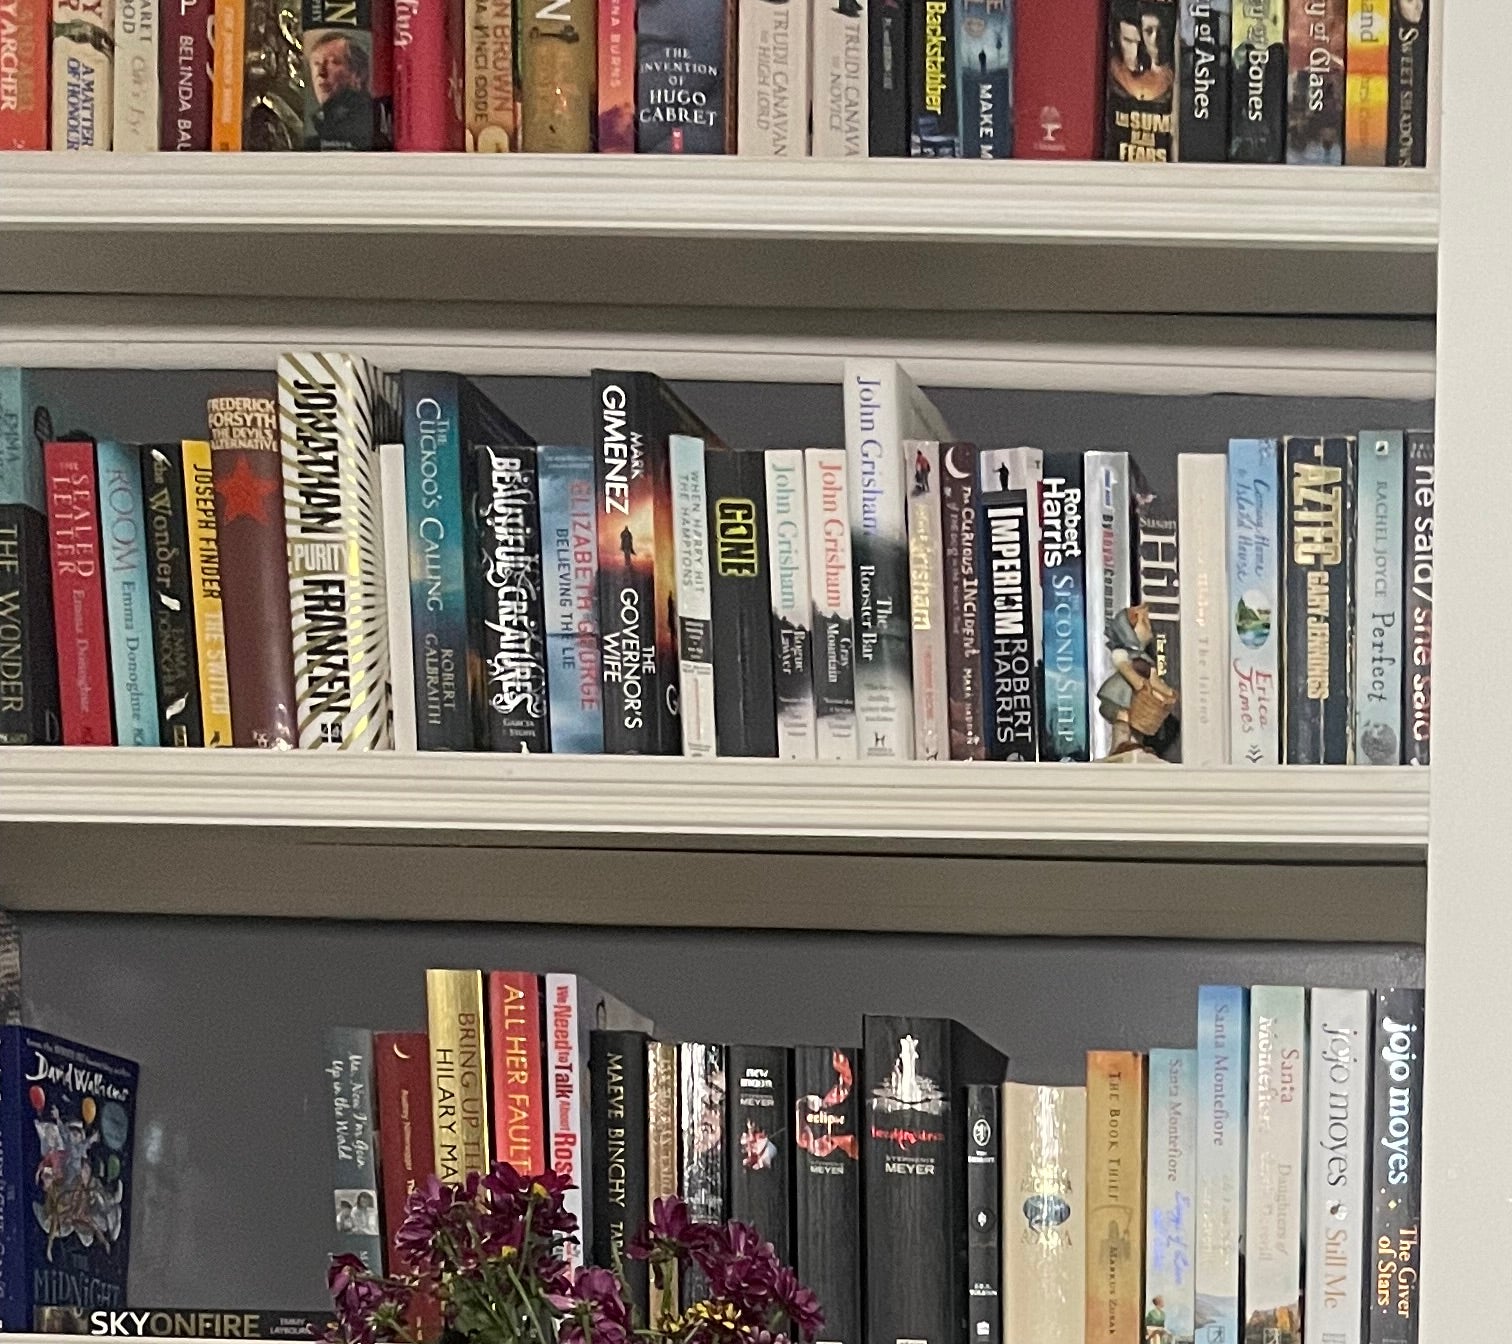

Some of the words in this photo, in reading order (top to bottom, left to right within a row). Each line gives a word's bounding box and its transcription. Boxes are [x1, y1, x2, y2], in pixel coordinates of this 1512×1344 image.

[1, 18, 17, 112] ARCHER
[178, 35, 194, 122] BELINDA
[640, 62, 718, 76] INVENTION
[665, 49, 691, 59] THE
[926, 2, 946, 114] Backstabber
[1194, 46, 1216, 120] Ashes
[1248, 51, 1269, 121] Bones
[1308, 47, 1330, 113] Glass
[79, 80, 95, 149] MATTER
[639, 109, 718, 126] CABRET
[650, 89, 706, 106] HUGO
[857, 375, 881, 432] John
[293, 380, 341, 533] JONATHAN
[602, 385, 630, 515] GIMENEZ
[193, 464, 215, 528] JOSEPH
[819, 461, 843, 515] John
[859, 440, 884, 537] Grisham
[1293, 462, 1342, 565] AZTEC
[0, 524, 17, 578] THE
[69, 475, 94, 579] SEALED
[718, 500, 757, 576] GONE
[1043, 478, 1066, 567] Harris
[1062, 488, 1082, 557] Robert
[199, 533, 222, 599] FINDER
[294, 544, 346, 571] PURITY
[556, 528, 573, 607] BELIEVING
[824, 521, 847, 609] Grisham
[987, 507, 1024, 635] IMPERIUM
[1140, 532, 1179, 621] Hill
[860, 565, 876, 628] Rooster
[876, 598, 893, 630] The
[0, 590, 24, 713] WONDER
[302, 579, 351, 714] FRANZEN
[563, 644, 576, 671] LIE
[603, 634, 622, 683] WIFE
[619, 588, 644, 729] GOVERNOR'S
[642, 646, 655, 674] THE
[861, 633, 874, 662] Bar
[1307, 621, 1330, 698] JENNINGS
[1367, 611, 1394, 703] Perfect
[440, 648, 455, 711] ROBERT
[994, 641, 1014, 743] HARRIS
[1010, 639, 1032, 743] ROBERT
[504, 985, 522, 1028] ALL
[506, 1035, 526, 1084] HER
[1322, 1022, 1358, 1083] jojo
[1382, 1017, 1416, 1081] jojo
[606, 1053, 623, 1117] MAEVE
[1106, 1072, 1121, 1101] THE
[1108, 1109, 1121, 1151] BOOK
[1321, 1091, 1349, 1188] moyes
[1382, 1090, 1409, 1186] moyes
[608, 1128, 625, 1208] BINCHY
[886, 1163, 934, 1174] MEYER
[1325, 1227, 1347, 1272] Still
[1378, 1237, 1390, 1257] of
[1399, 1226, 1417, 1262] The
[1324, 1275, 1347, 1309] Me
[1378, 1260, 1396, 1306] Stars
[1398, 1267, 1417, 1318] Giver
